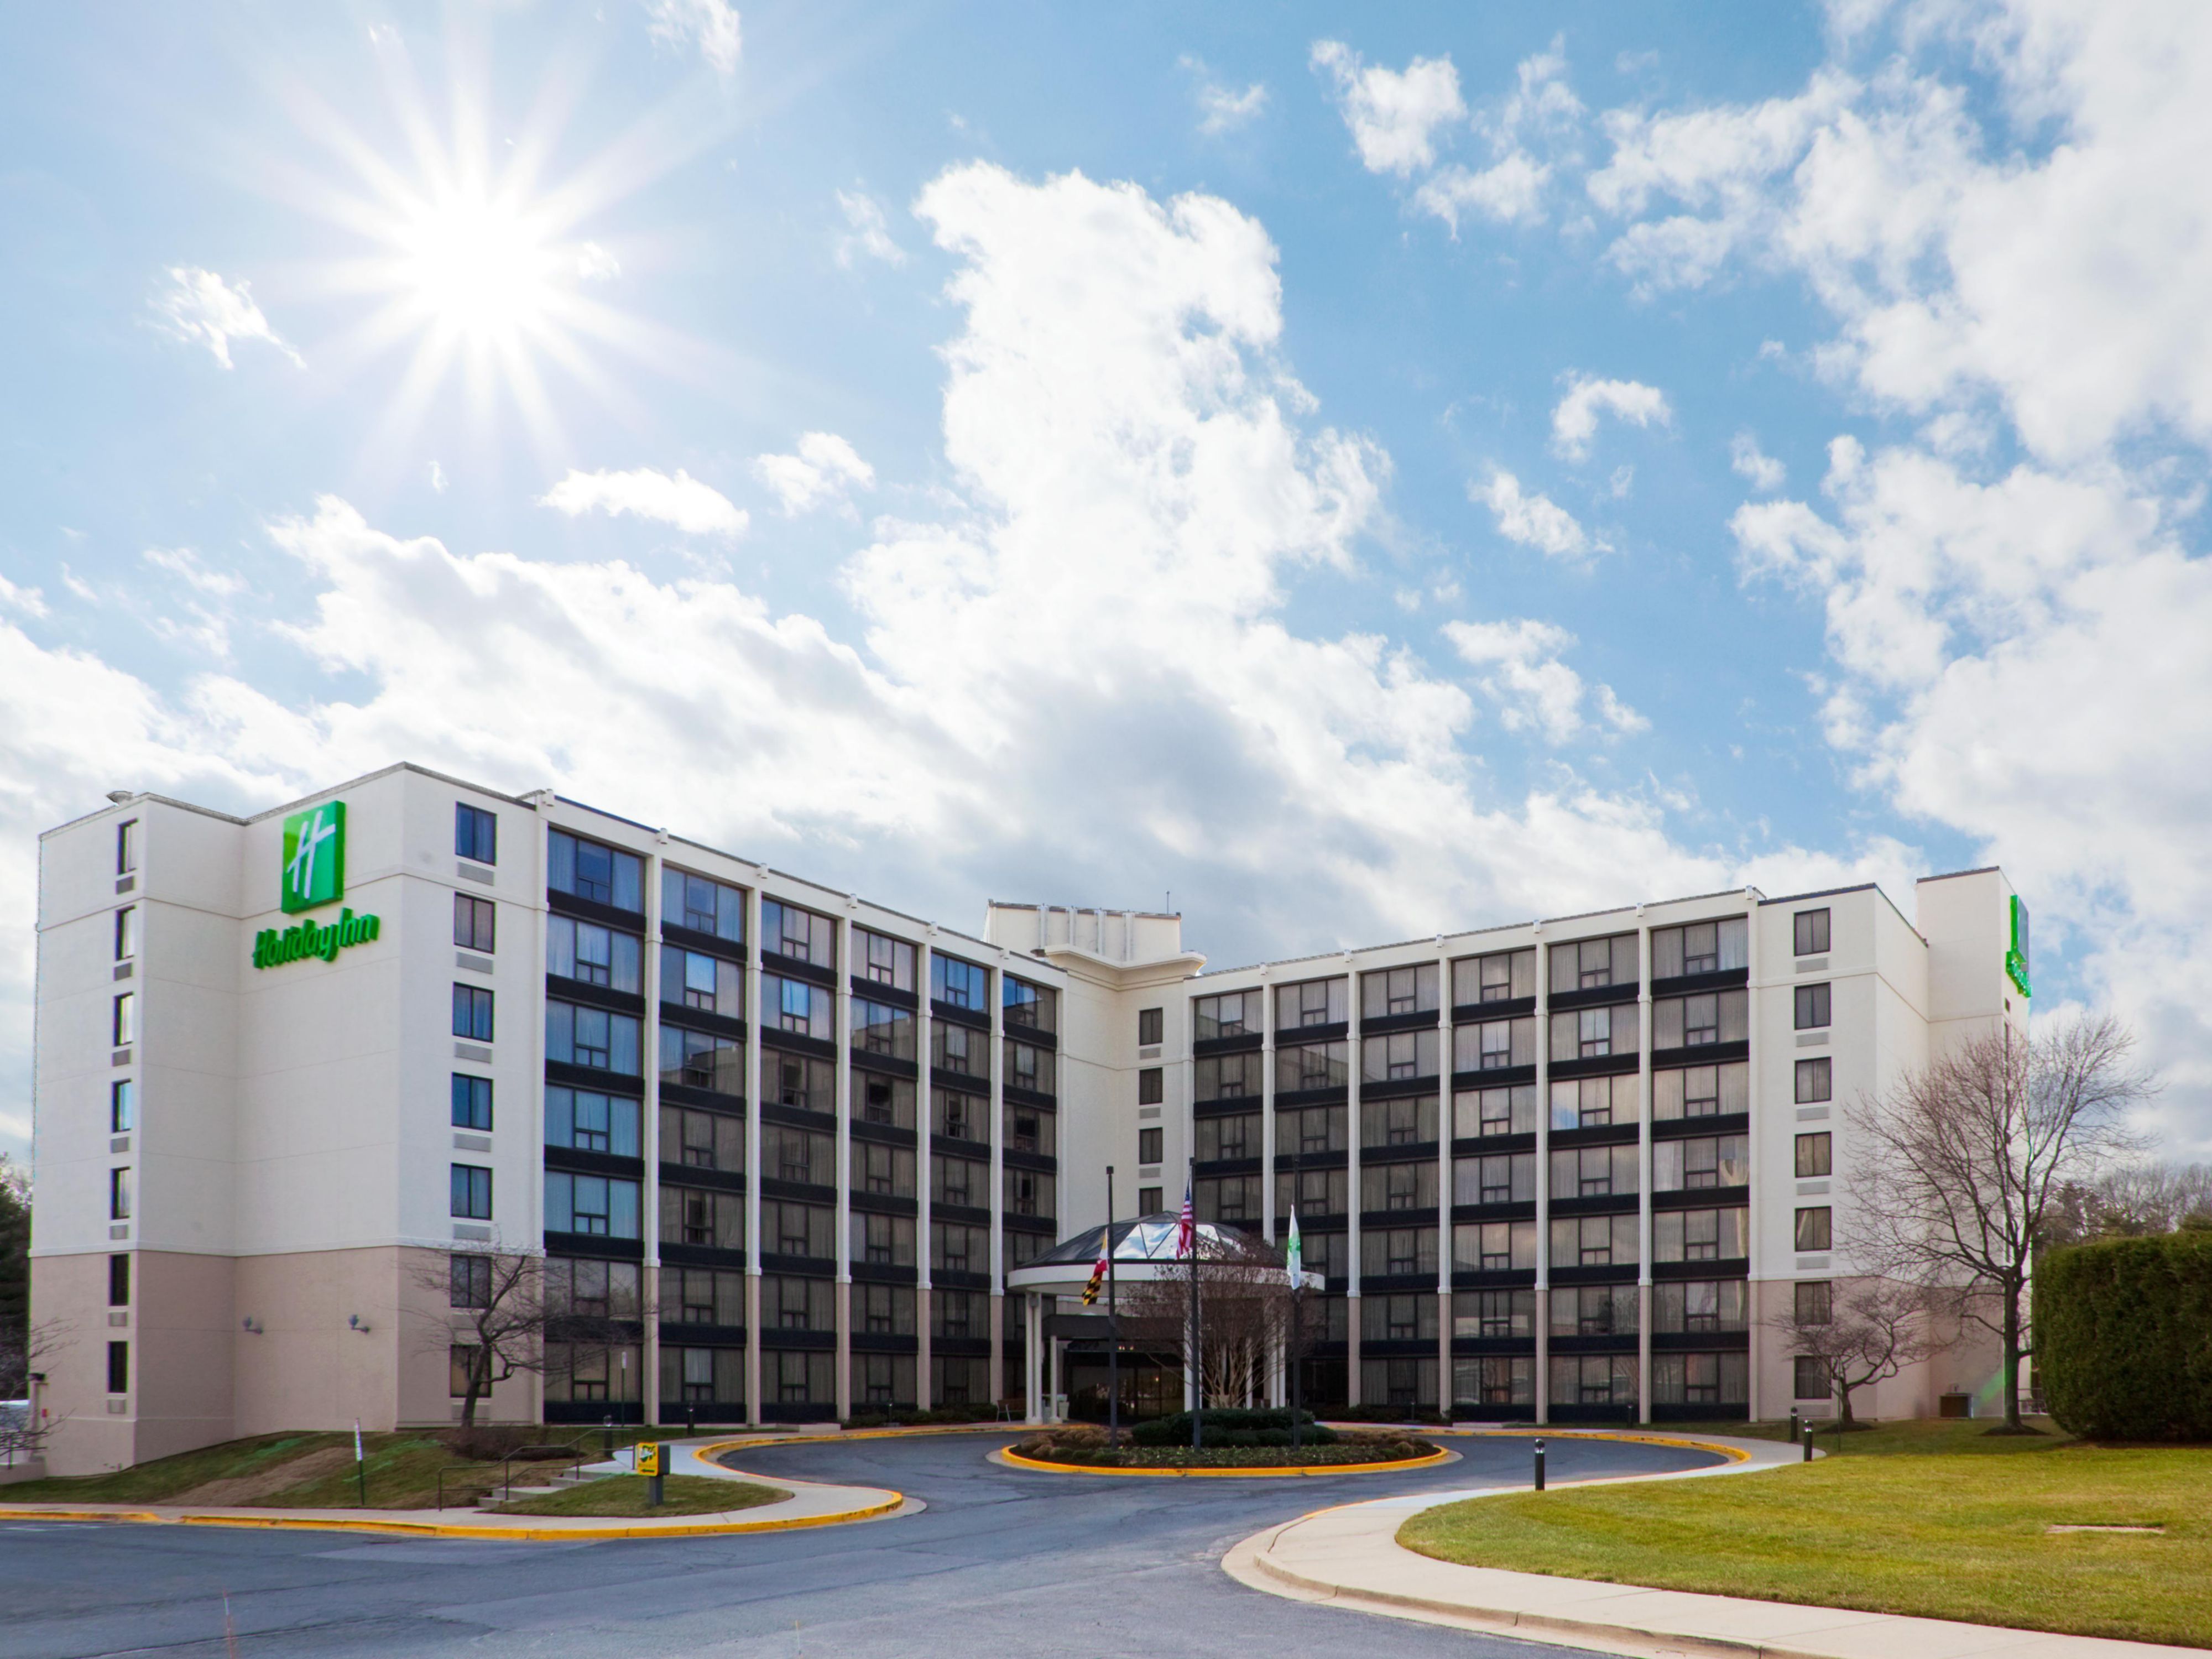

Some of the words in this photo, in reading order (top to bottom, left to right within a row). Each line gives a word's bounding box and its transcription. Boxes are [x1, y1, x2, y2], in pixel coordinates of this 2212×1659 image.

[288, 810, 336, 899] H
[253, 919, 339, 969] Holiday
[339, 907, 379, 947] Inn
